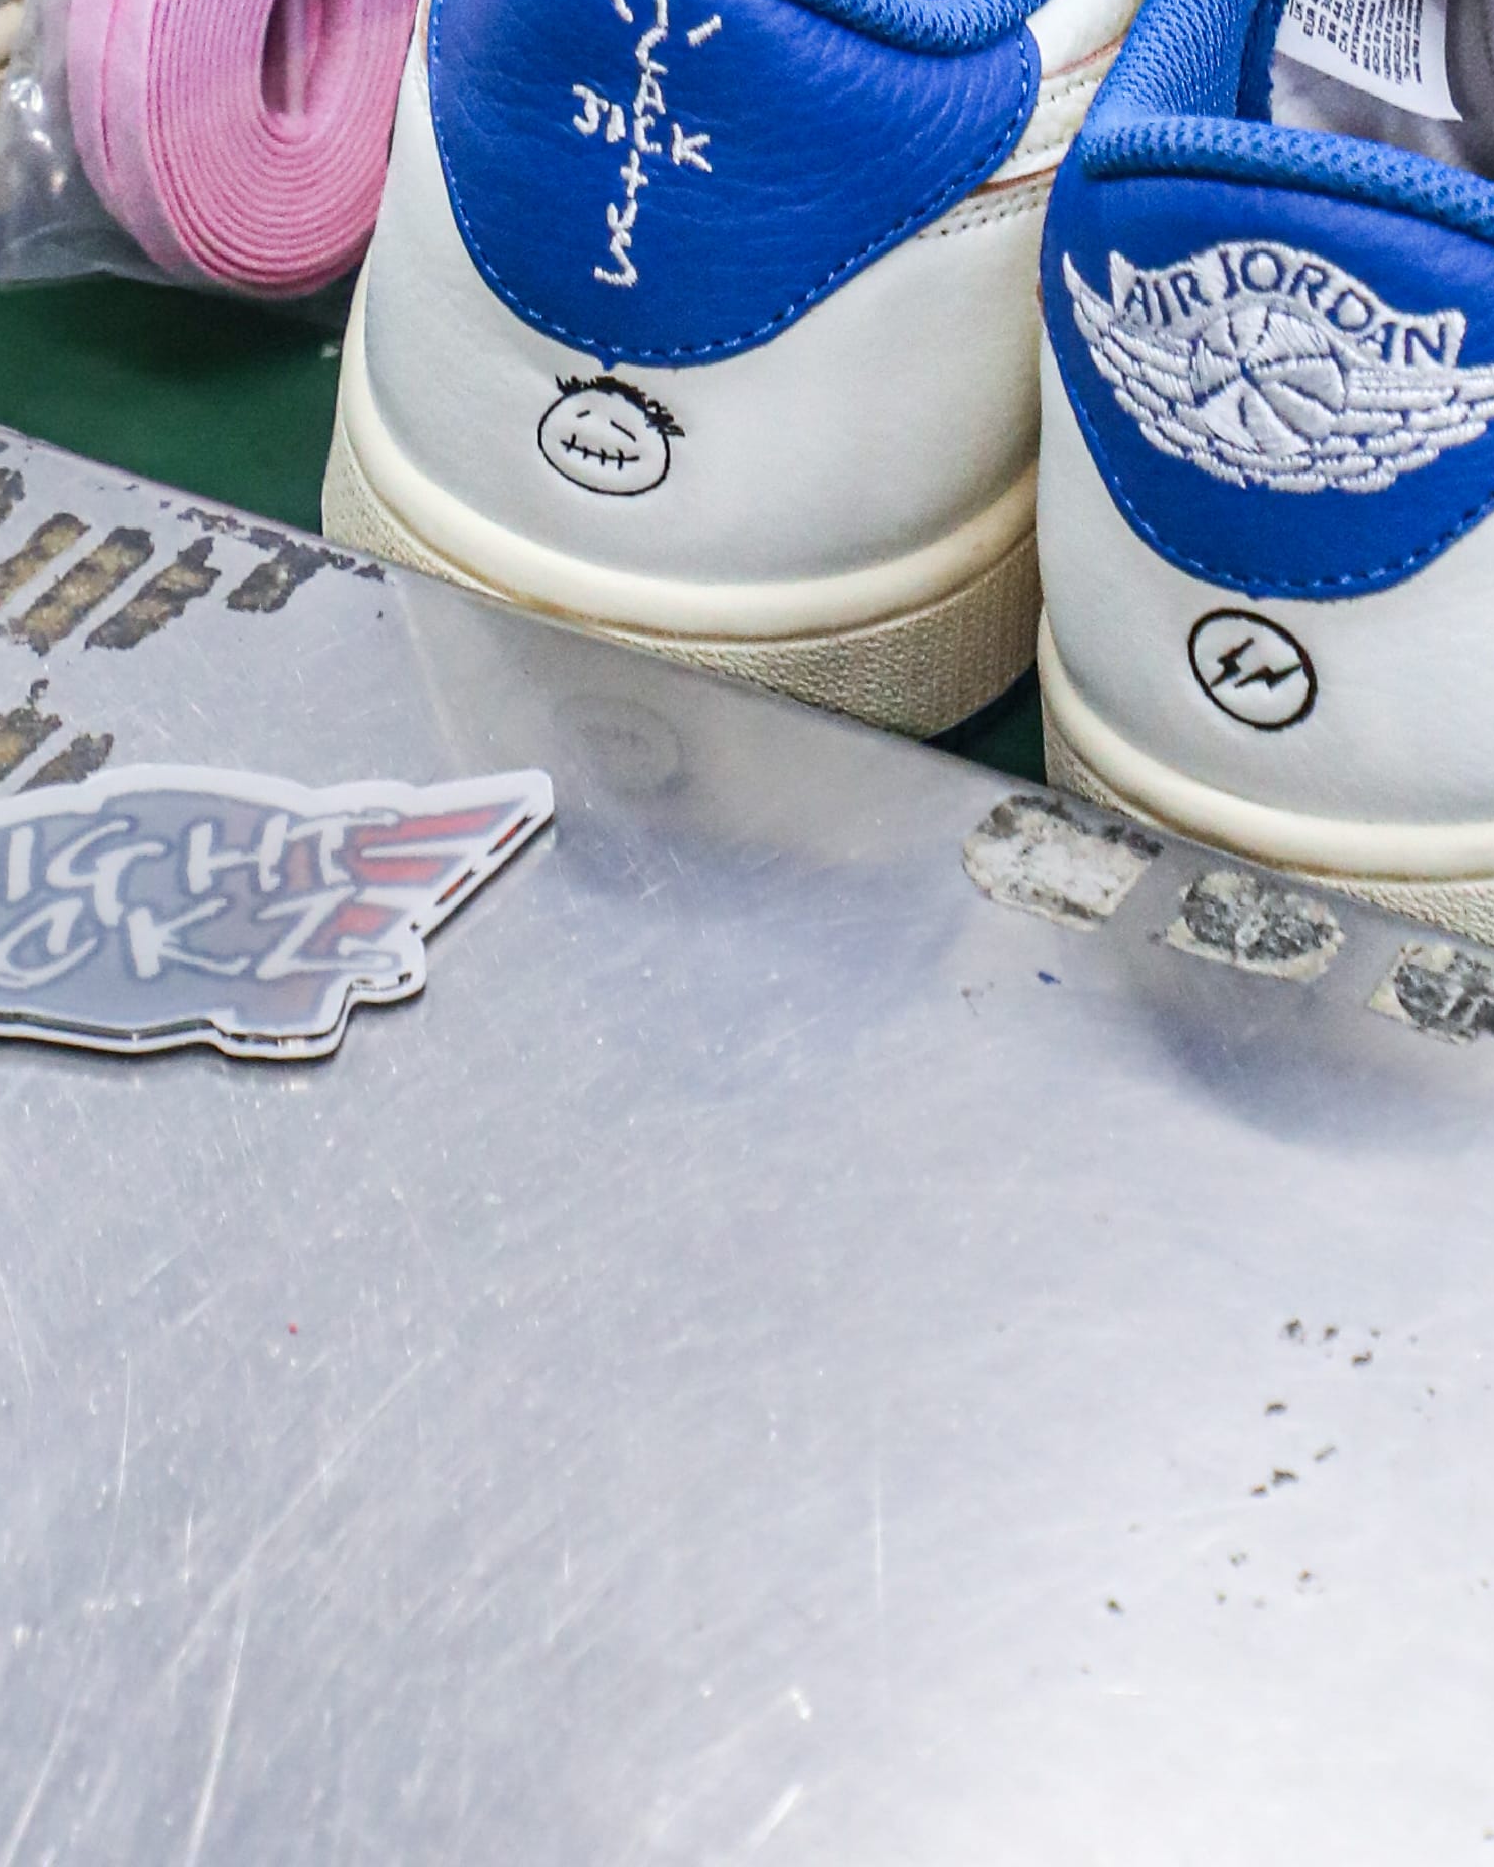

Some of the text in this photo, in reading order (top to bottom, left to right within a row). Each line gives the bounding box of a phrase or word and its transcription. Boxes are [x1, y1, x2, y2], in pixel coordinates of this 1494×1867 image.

[1302, 6, 1317, 37] EUR
[1124, 249, 1446, 366] AIR JORDAN
